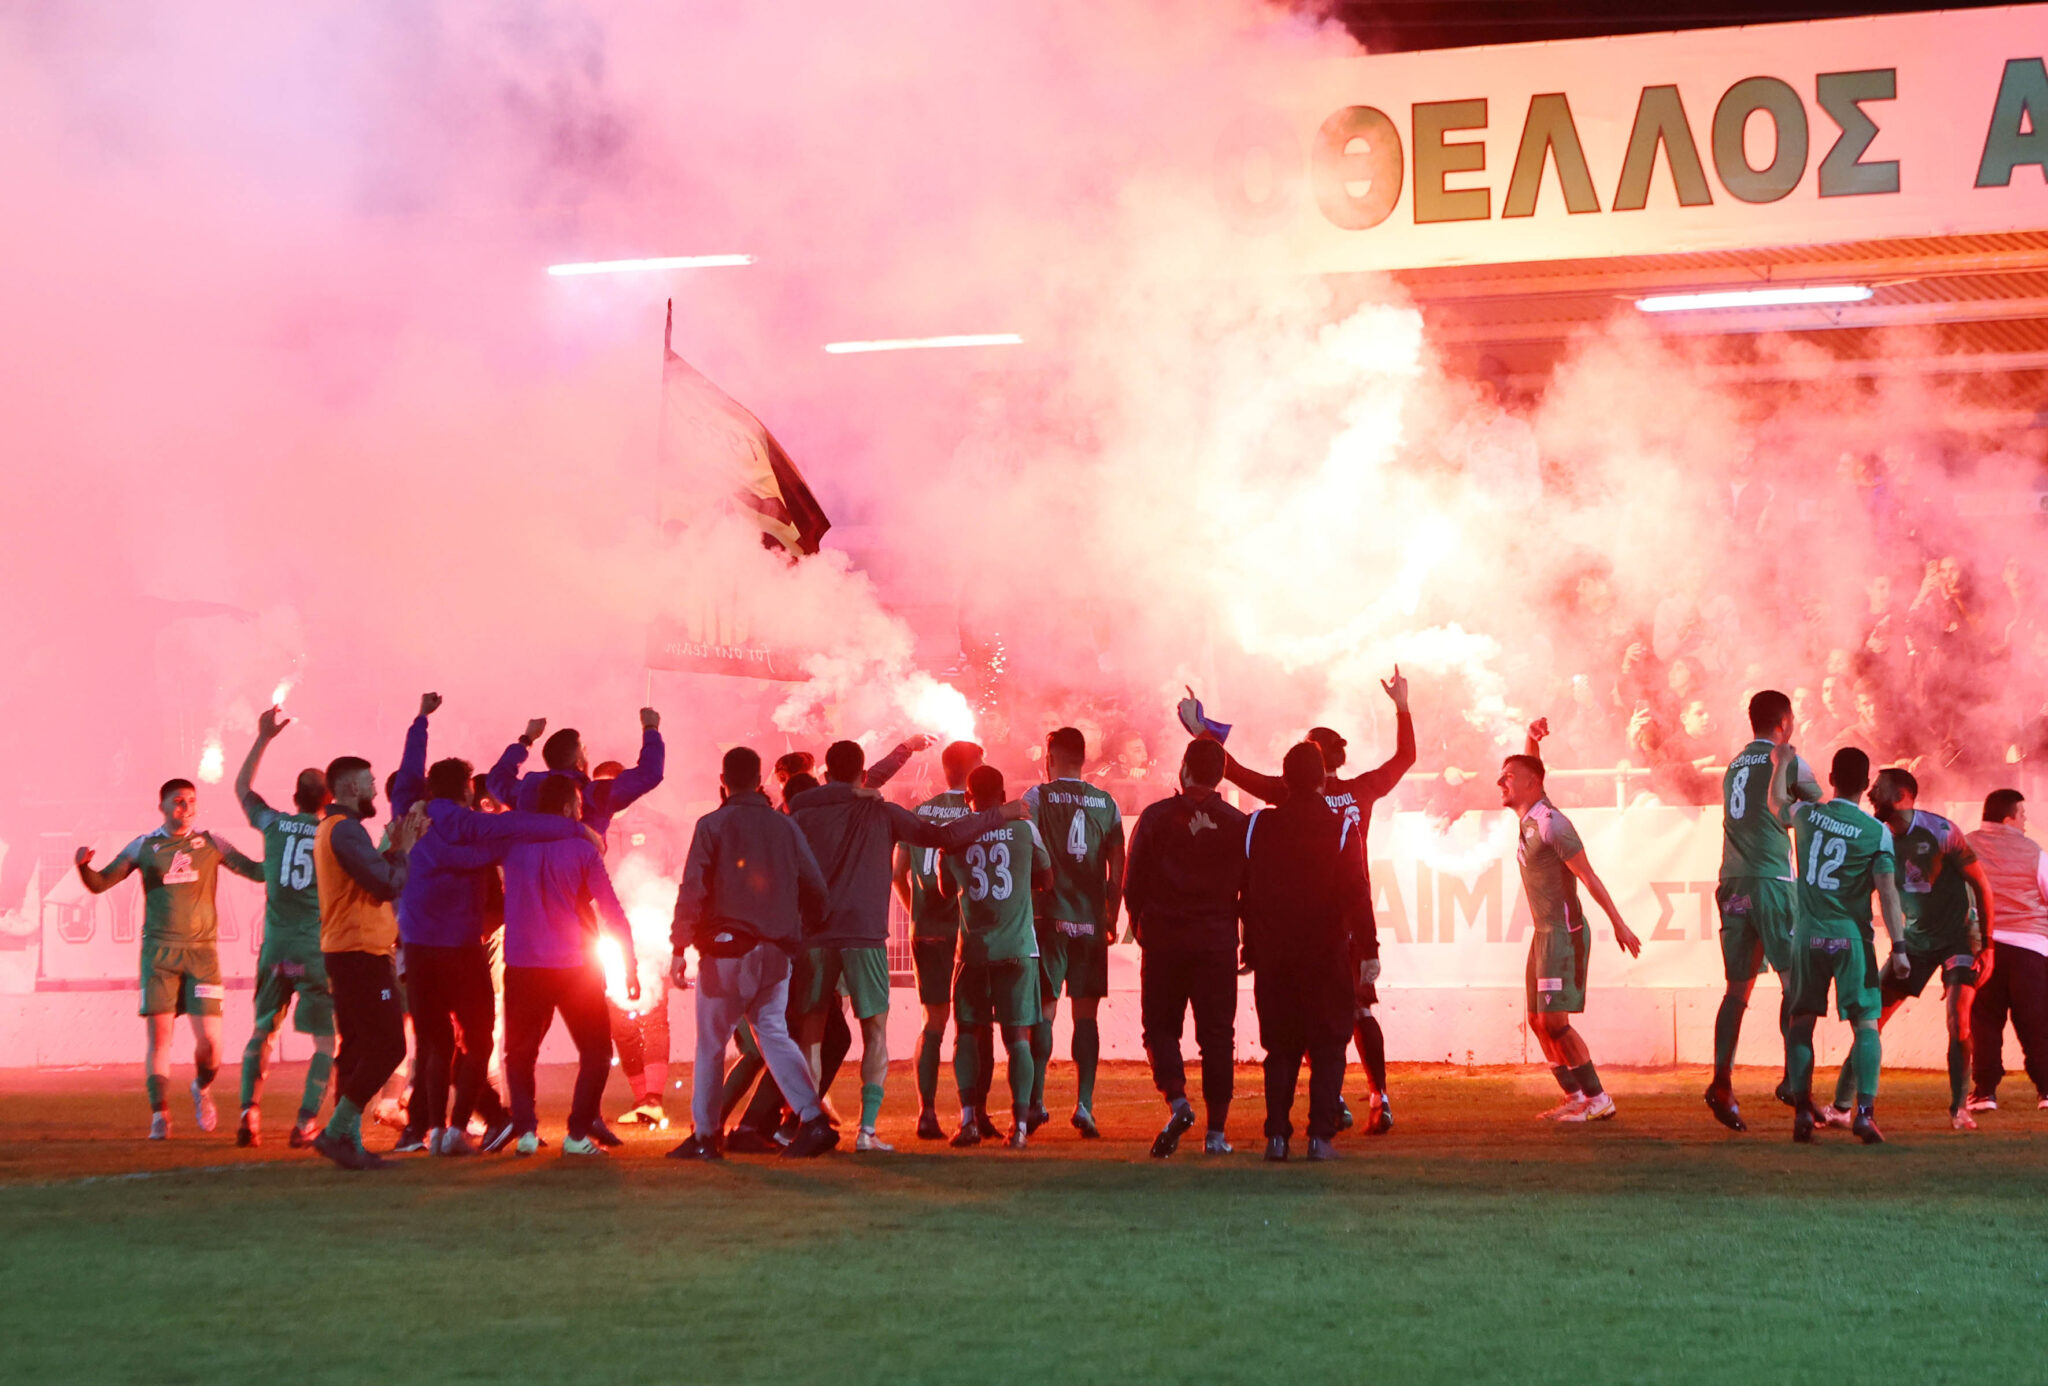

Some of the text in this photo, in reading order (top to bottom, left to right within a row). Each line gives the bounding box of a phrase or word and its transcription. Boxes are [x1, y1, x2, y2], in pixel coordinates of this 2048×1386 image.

[1730, 766, 1750, 820] 8
[280, 834, 315, 891] 15
[1067, 808, 1088, 863] 4
[1806, 830, 1847, 890] 12
[965, 842, 1013, 901] 33
